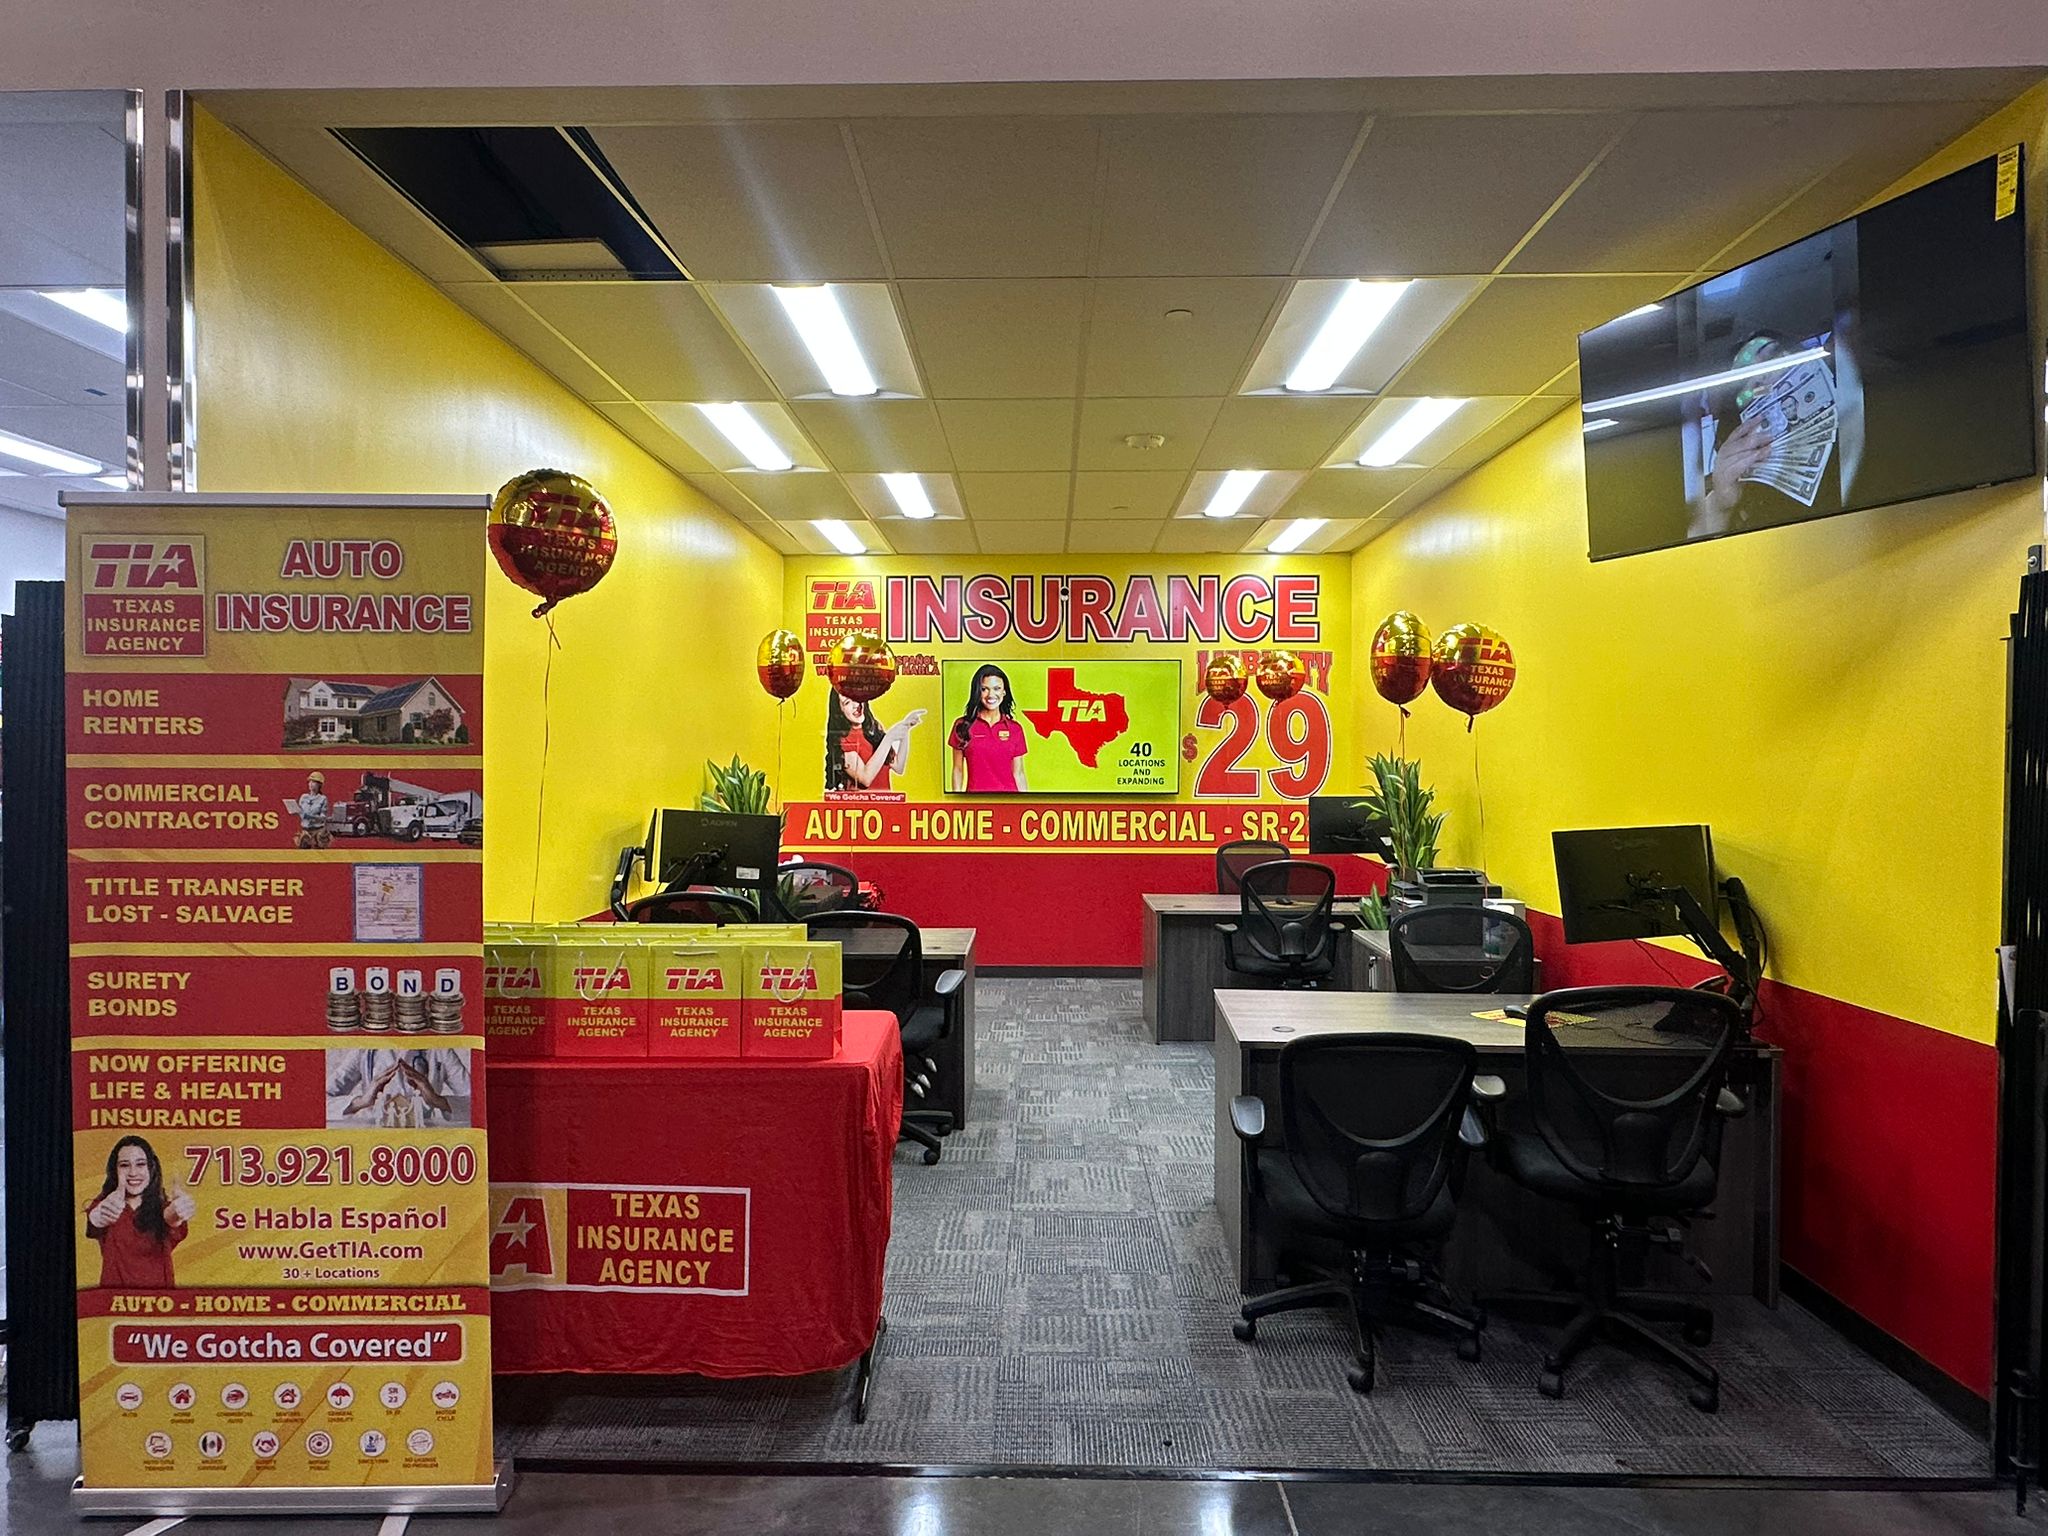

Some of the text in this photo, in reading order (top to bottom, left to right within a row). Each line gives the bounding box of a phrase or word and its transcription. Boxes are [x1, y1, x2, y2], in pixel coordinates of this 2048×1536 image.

[88, 543, 200, 589] TIA
[280, 540, 404, 579] AUTO
[811, 580, 877, 610] TIA
[113, 599, 175, 614] TEXAS
[214, 594, 472, 633] INSURANCE
[885, 575, 1320, 644] INSURANCE
[87, 618, 201, 632] INSURANCE
[825, 616, 863, 625] TEXAS
[105, 637, 184, 652] AGENCY
[1471, 664, 1504, 676] TEXAS
[82, 689, 160, 708] HOME
[1057, 699, 1107, 723] TIA
[82, 717, 205, 736] RENTERS
[1130, 743, 1152, 757] 40
[1118, 759, 1166, 767] LOCATIONS
[1133, 768, 1151, 776] AND
[1117, 777, 1165, 785] EXPANDING
[84, 784, 259, 803] COMMERCIAL
[84, 811, 279, 830] CONTRACTORS
[804, 809, 883, 841] AUTO
[909, 809, 994, 842] HOME
[1020, 810, 1215, 842] COMMERCIAL
[1242, 810, 1310, 842] SR-2
[85, 878, 304, 897] TITLE TRANSFER
[86, 905, 152, 924] LOST
[175, 905, 294, 924] SALVAGE
[87, 971, 191, 990] SURETY
[572, 967, 632, 991] TIA
[665, 967, 726, 991] TIA
[759, 967, 820, 992] TIA
[88, 999, 178, 1017] BONDS
[493, 1005, 531, 1014] TEXAS
[582, 1007, 621, 1016] TEXAS
[675, 1007, 714, 1016] TEXAS
[769, 1007, 808, 1016] TEXAS
[484, 1016, 545, 1025] NSURANCE
[567, 1017, 636, 1026] INSURANCE
[660, 1018, 729, 1027] INSURANCE
[754, 1018, 823, 1027] INSURANCE
[487, 1026, 536, 1035] AGENCY
[577, 1028, 626, 1037] AGENCY
[670, 1029, 719, 1037] AGENCY
[764, 1029, 813, 1038] AGENCY
[89, 1055, 287, 1074] NOW OFFERING
[90, 1082, 282, 1100] LIFE & HEALTH
[90, 1109, 243, 1127] INSURANCE
[184, 1145, 477, 1187] 713.921.8000
[611, 1193, 701, 1219] TEXAS
[214, 1205, 447, 1234] Se Habla Español
[577, 1226, 735, 1253] INSURANCE
[239, 1241, 424, 1260] www.GetTIA.com
[283, 1268, 299, 1279] 30
[315, 1266, 380, 1279] Locations
[599, 1258, 712, 1285] AGENCY
[110, 1296, 174, 1313] AUTO
[195, 1296, 271, 1313] HOME
[291, 1295, 466, 1312] COMMERCIAL
[126, 1331, 449, 1359] “We Gotcha Covered”
